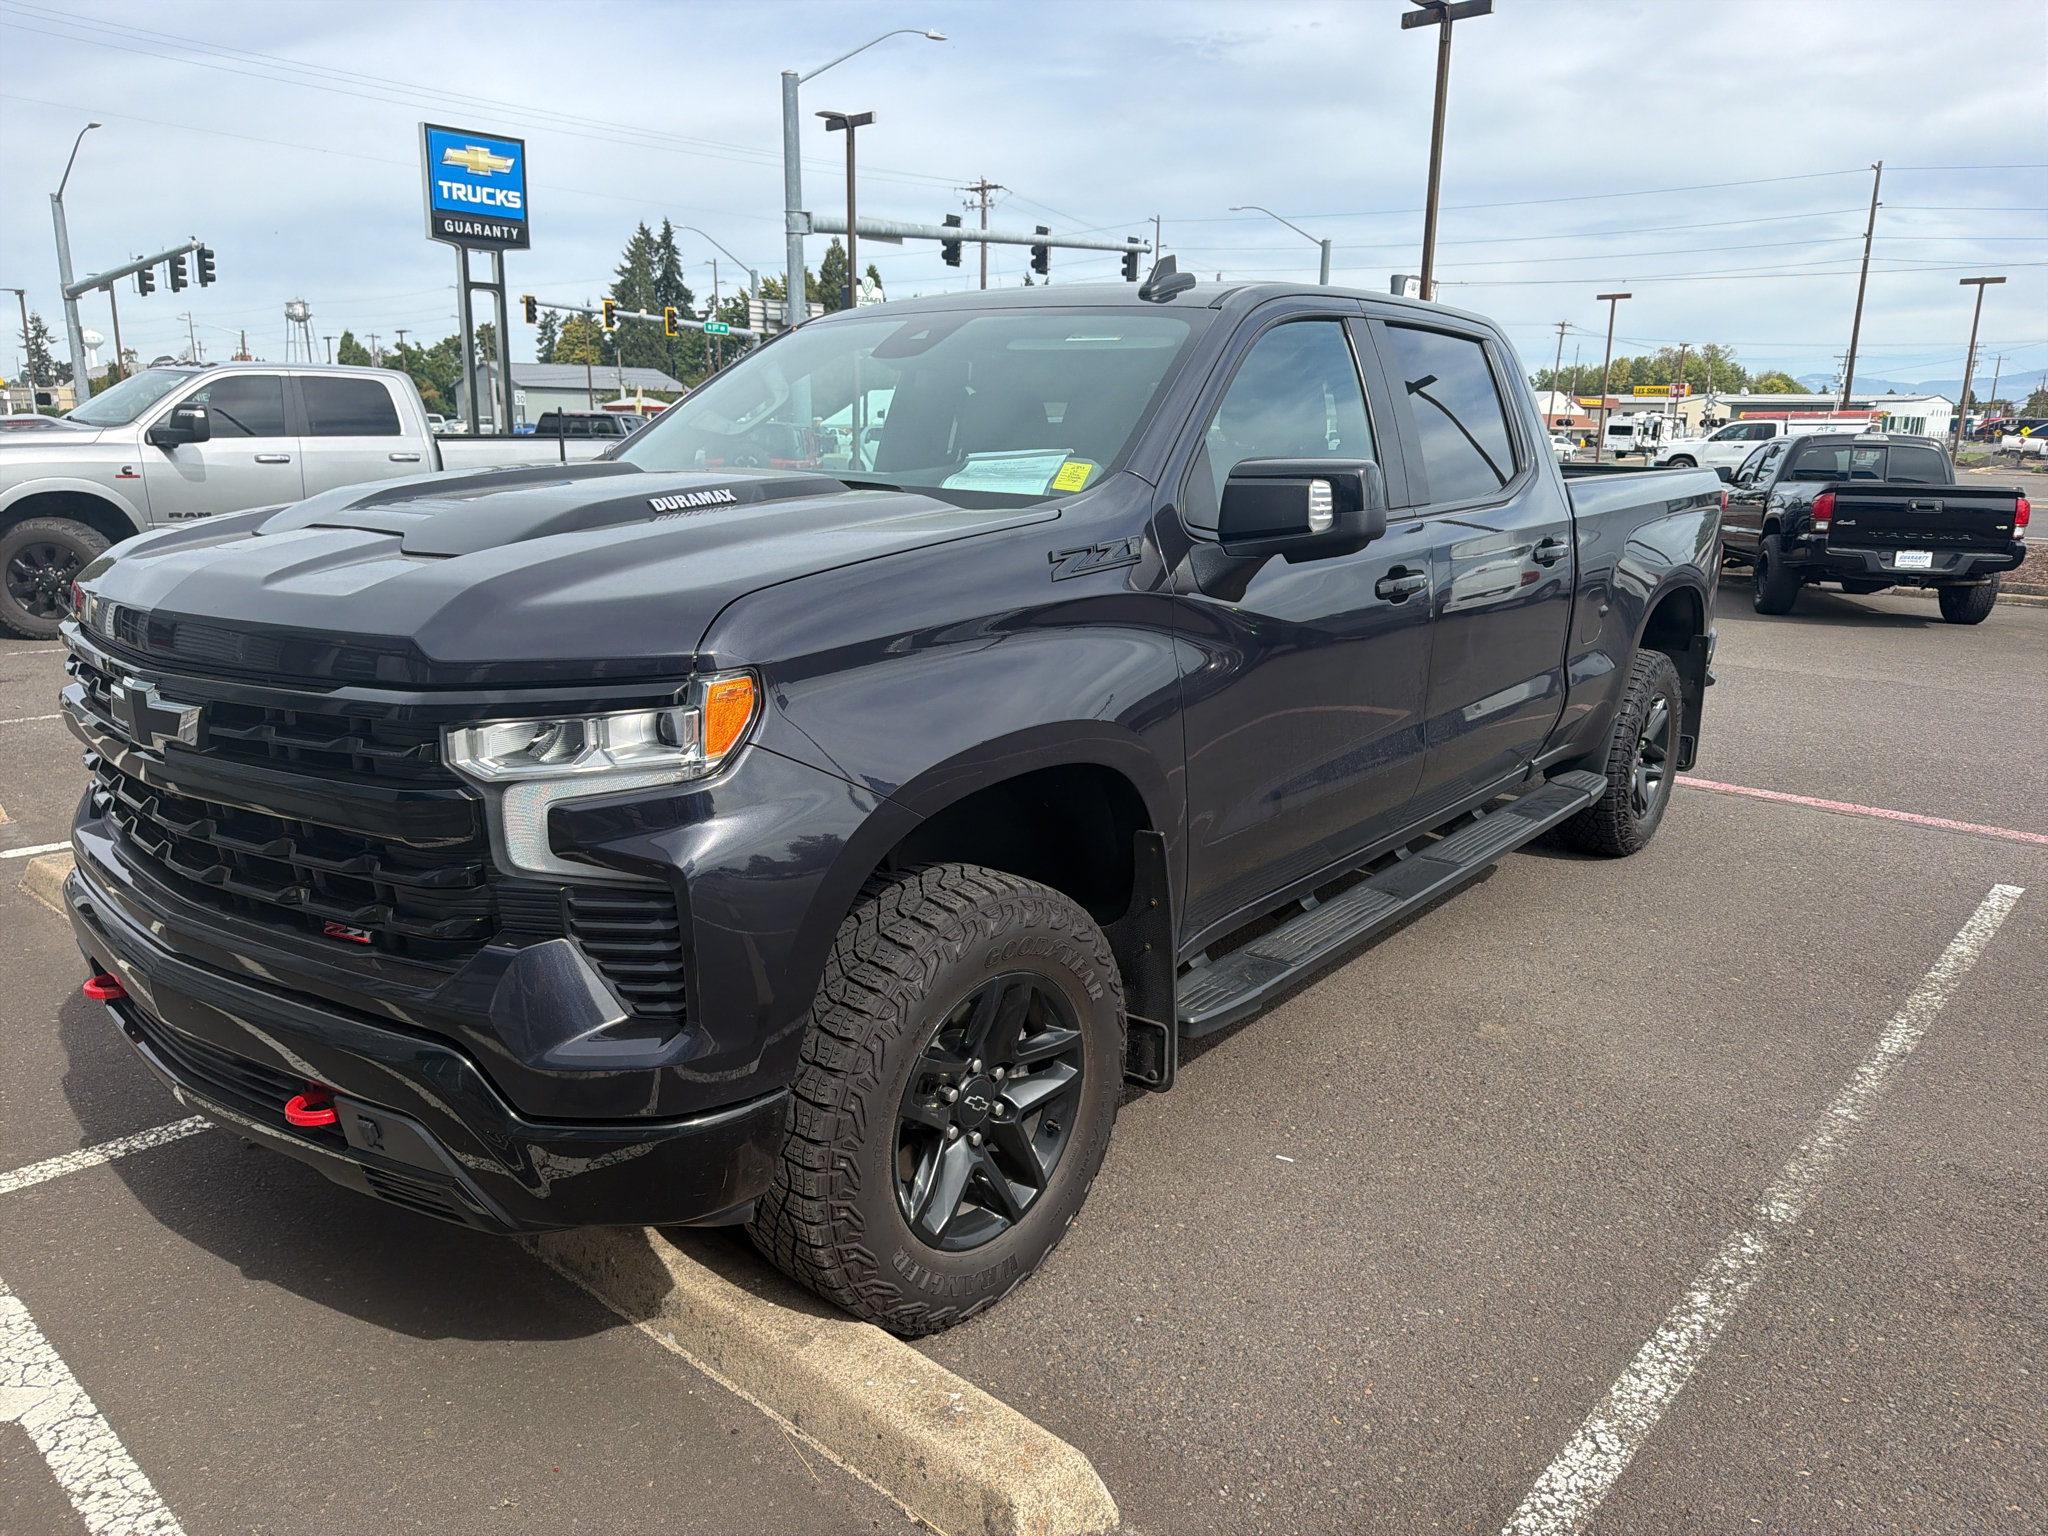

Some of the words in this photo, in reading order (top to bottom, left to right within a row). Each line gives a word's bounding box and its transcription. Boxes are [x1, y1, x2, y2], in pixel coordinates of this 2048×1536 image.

[438, 180, 521, 209] TRUCKS
[444, 219, 518, 240] GUARANTY
[515, 395, 526, 404] 30
[1635, 387, 1645, 395] LES
[648, 489, 738, 513] DURAMAX
[1868, 531, 1973, 541] TACOMA
[1048, 535, 1142, 582] Z71
[323, 920, 373, 943] Z71
[984, 935, 1105, 1001] GOODYEAR
[892, 1246, 1019, 1298] WRANGLER
